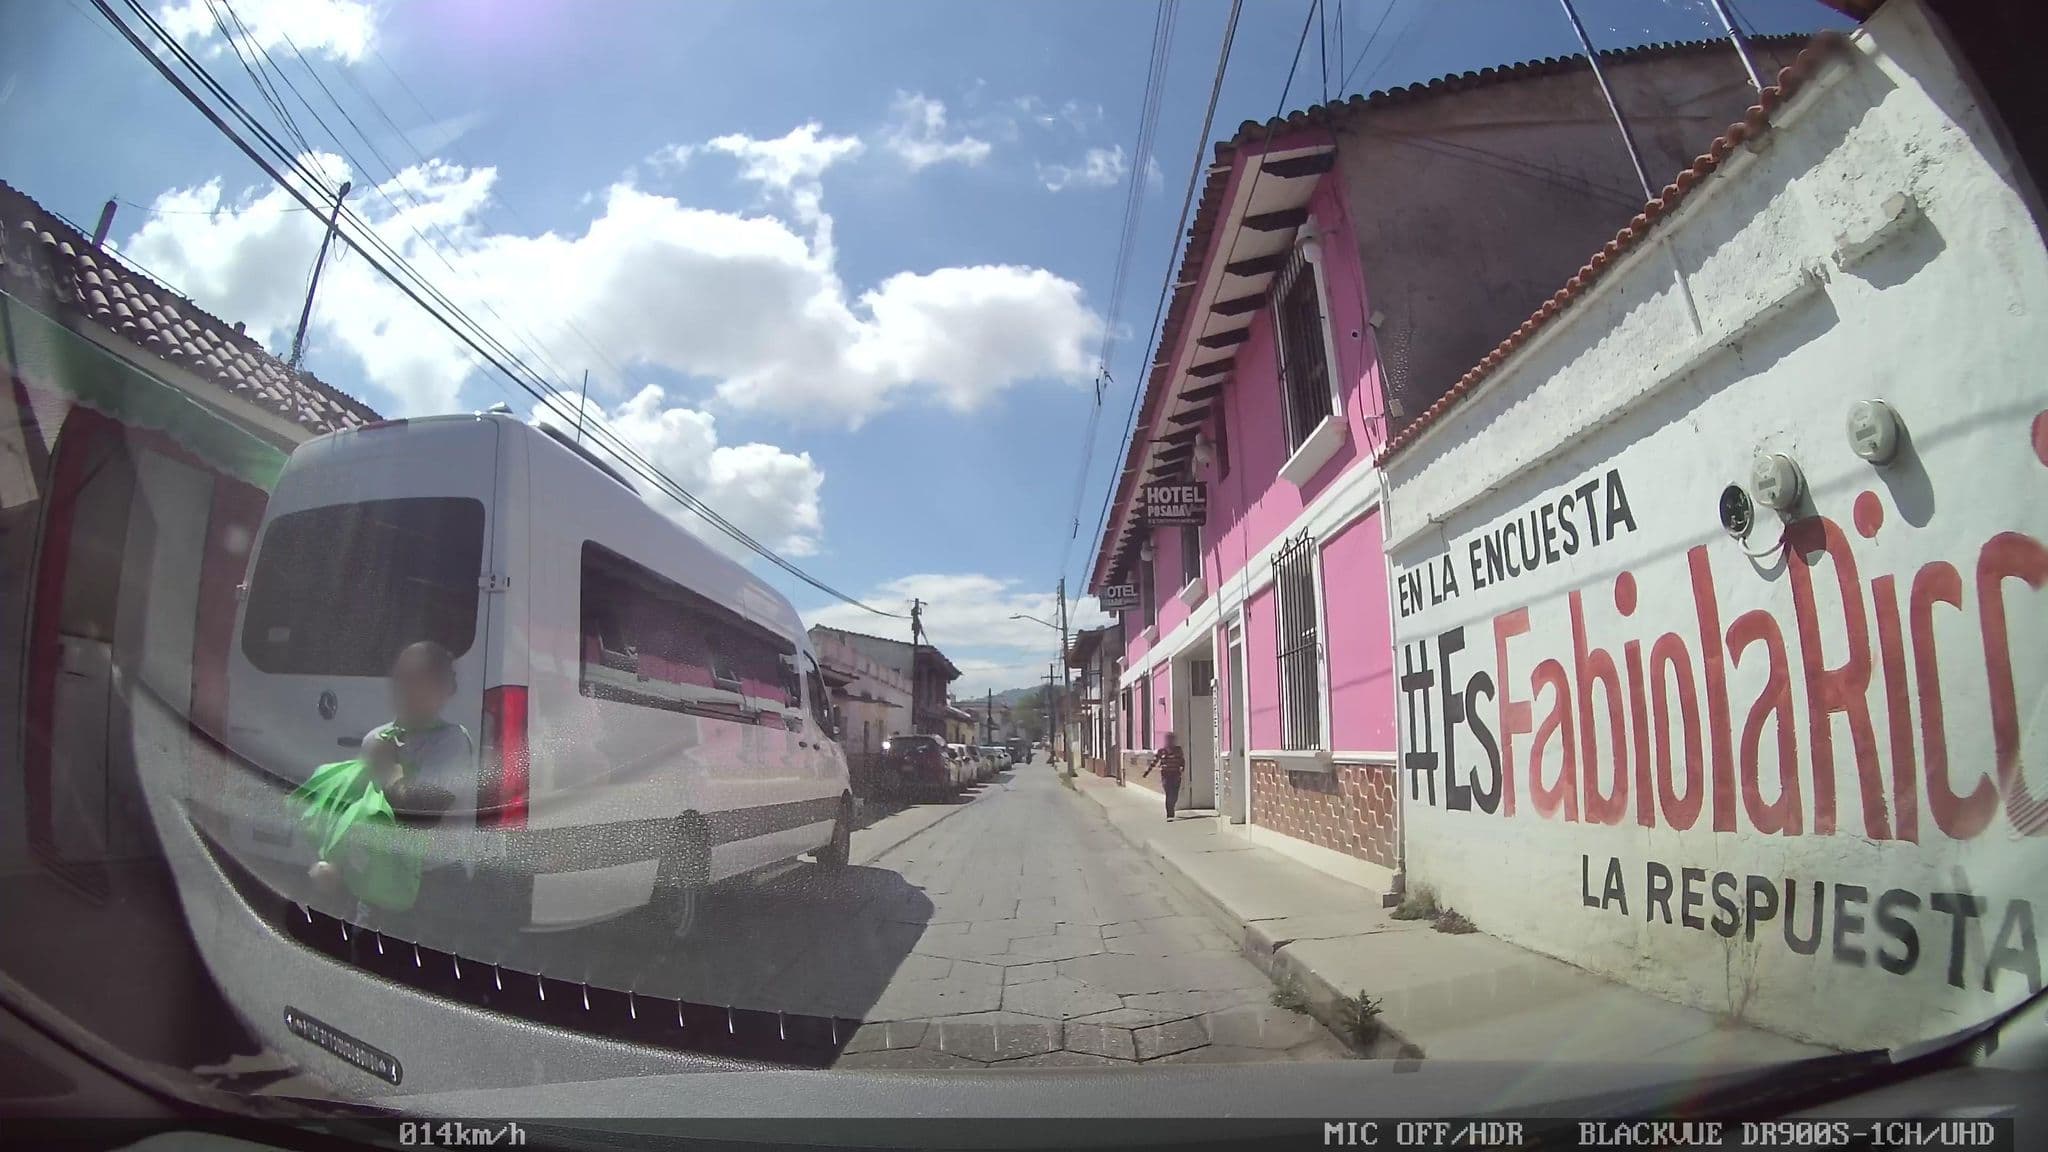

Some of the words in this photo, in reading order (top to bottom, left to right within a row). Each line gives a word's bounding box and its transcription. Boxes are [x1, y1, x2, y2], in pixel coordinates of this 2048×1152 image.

[1147, 486, 1205, 504] HOTEL
[1147, 505, 1186, 517] POSADA
[1398, 568, 1423, 617] EN
[1429, 554, 1459, 606] LA
[1469, 469, 1637, 590] ENCUESTA
[1101, 584, 1138, 598] OTEL
[1401, 409, 2048, 845] #EsFabiolaRicc
[1583, 854, 1629, 915] LA
[1647, 862, 2041, 993] RESPUESTA
